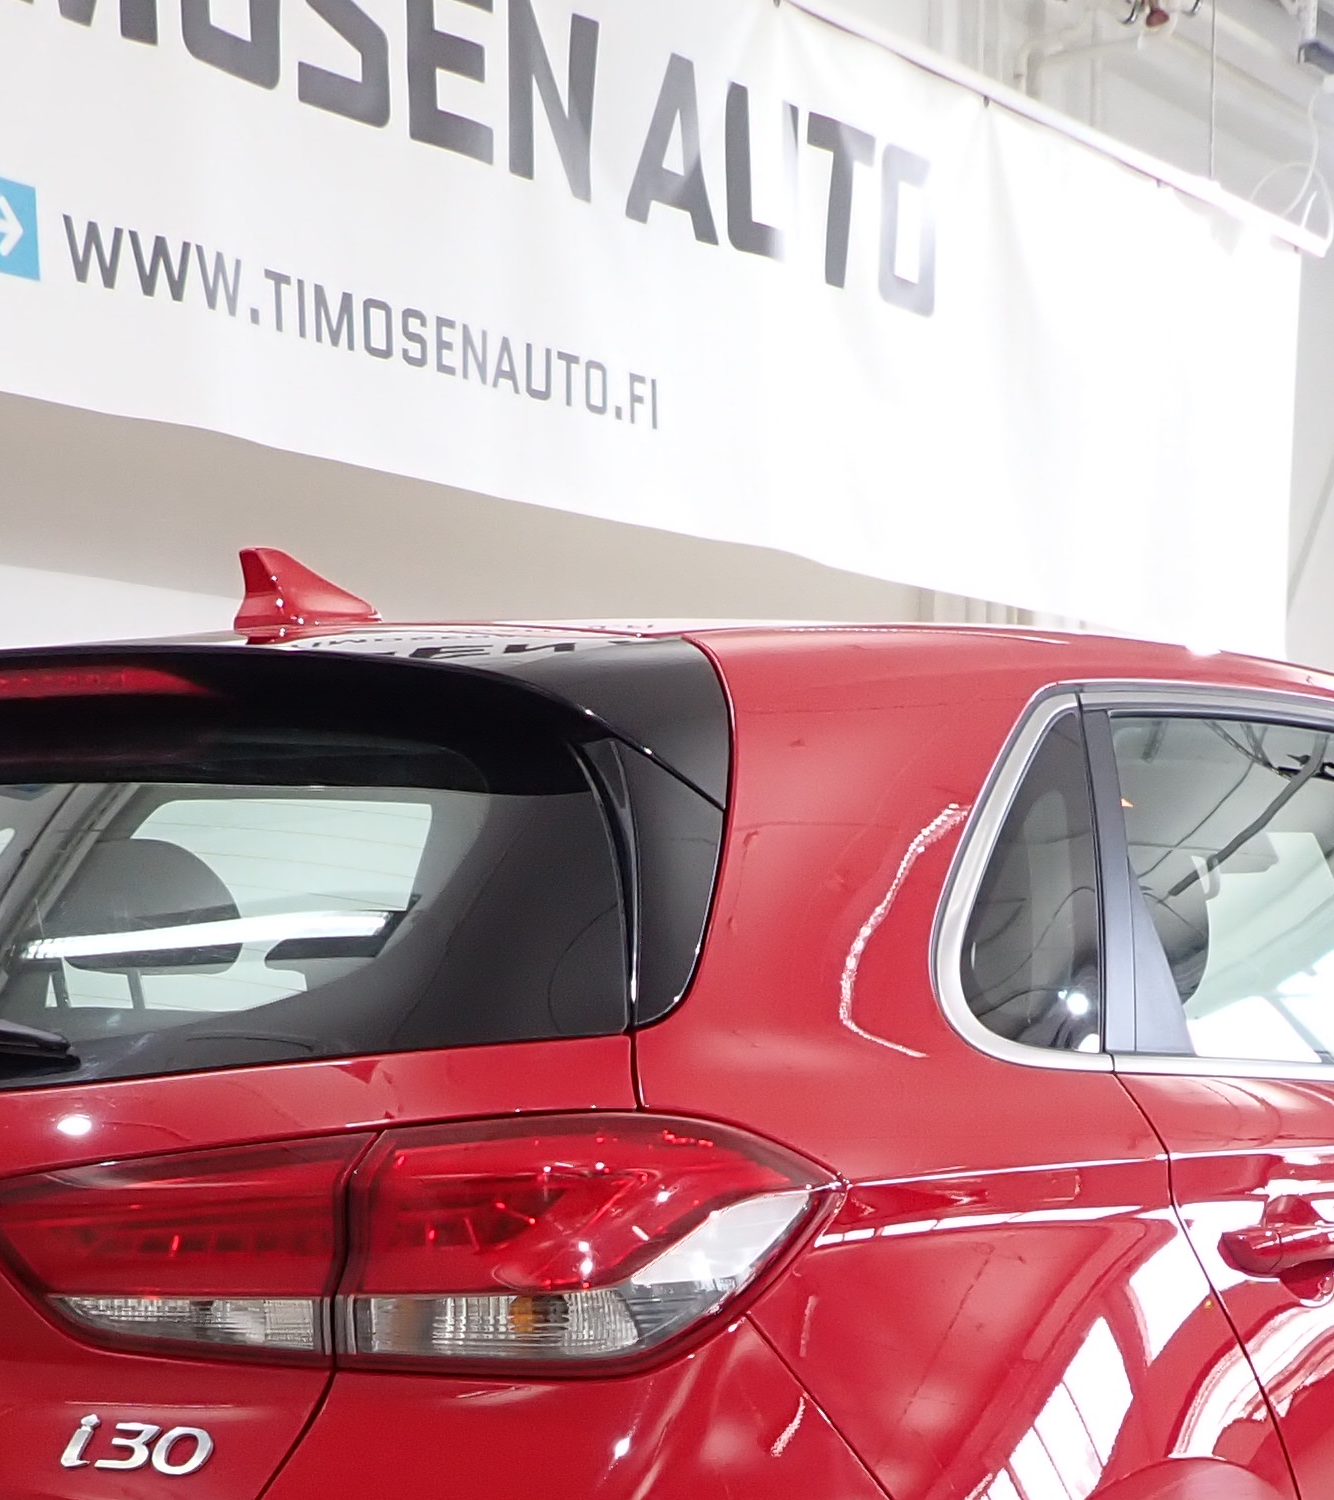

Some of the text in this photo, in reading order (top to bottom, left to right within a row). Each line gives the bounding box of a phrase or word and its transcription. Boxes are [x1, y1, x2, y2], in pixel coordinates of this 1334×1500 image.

[625, 52, 937, 318] AUTO
[62, 213, 658, 430] WWW.TIMOSENAUTO.FI
[60, 1413, 214, 1476] i30
